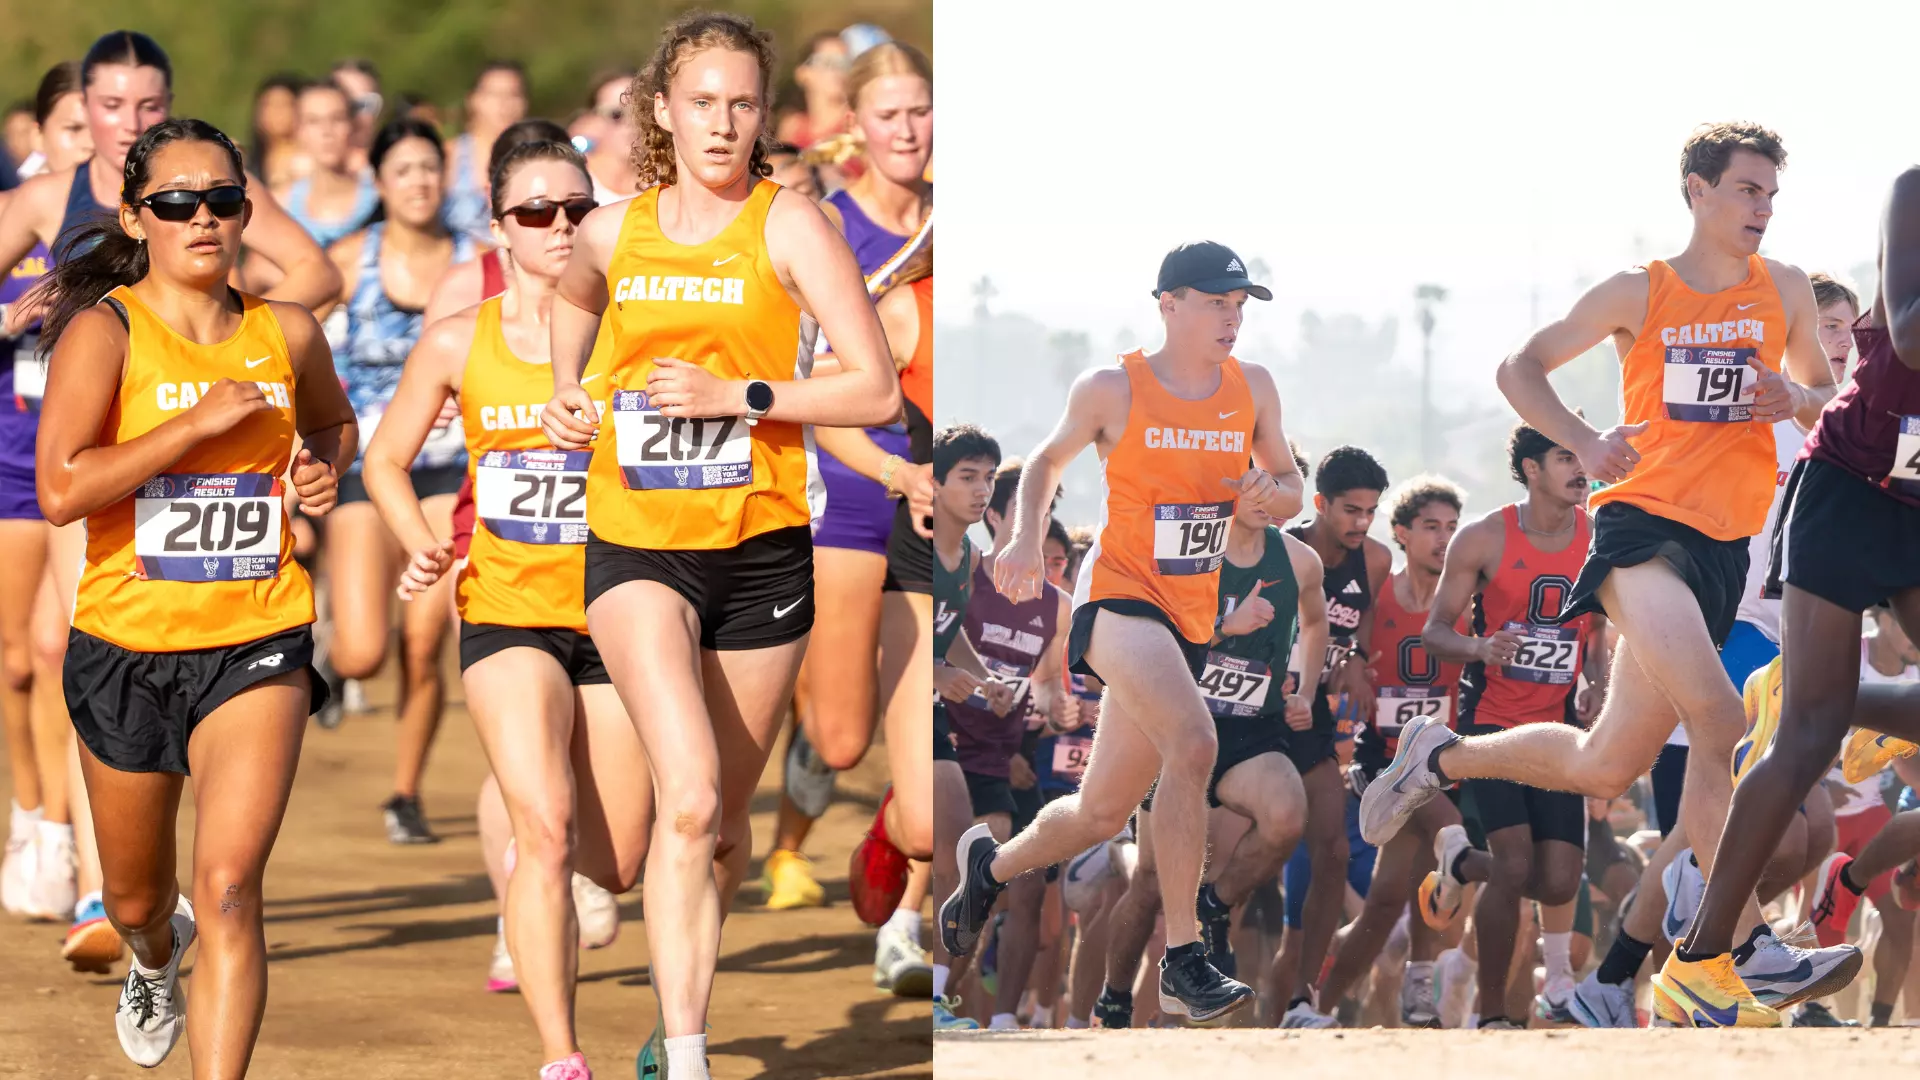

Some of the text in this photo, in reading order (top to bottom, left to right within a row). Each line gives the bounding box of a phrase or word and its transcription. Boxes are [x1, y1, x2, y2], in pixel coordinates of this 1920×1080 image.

[614, 275, 745, 305] CALTECH
[1660, 318, 1764, 346] CALTECH
[1696, 367, 1744, 403] 191
[640, 415, 738, 462] 207
[1144, 427, 1246, 453] CALTECH
[193, 488, 235, 497] RESULTS
[196, 477, 237, 486] FINISHED
[509, 473, 587, 519] 212
[163, 501, 270, 552] 209
[1179, 520, 1227, 556] 190
[1514, 641, 1573, 670] 622
[1200, 669, 1264, 702] 497
